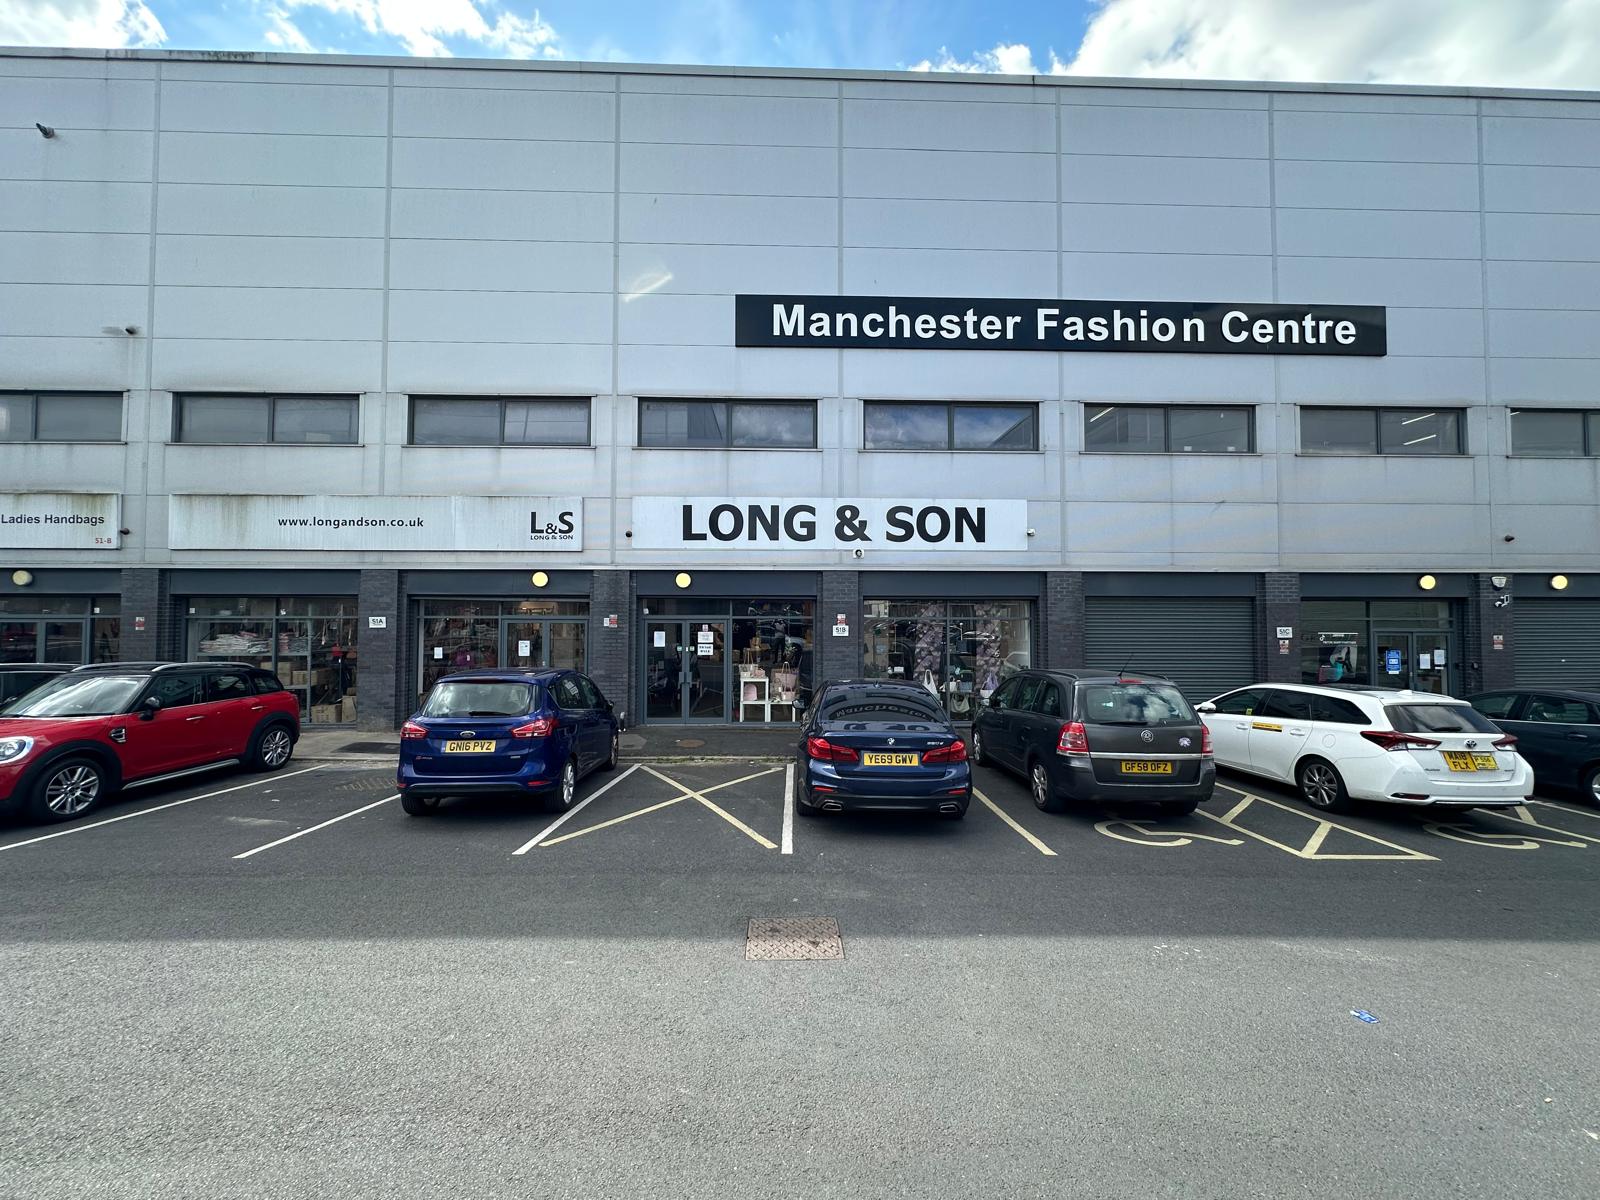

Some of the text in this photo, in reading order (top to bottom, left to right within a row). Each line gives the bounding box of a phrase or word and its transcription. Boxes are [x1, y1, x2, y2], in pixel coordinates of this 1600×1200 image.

[772, 304, 1357, 345] Manchester Fashion Centre
[1, 514, 105, 526] Ladies Handbags
[277, 516, 425, 529] www.longandson.co.uk
[531, 511, 574, 535] L&S
[682, 503, 986, 543] LONG & SON
[449, 741, 471, 751] GN16
[868, 754, 914, 764] YE69 GWV
[1452, 761, 1472, 769] FLX
[1124, 762, 1169, 772] GF58 OFZ
